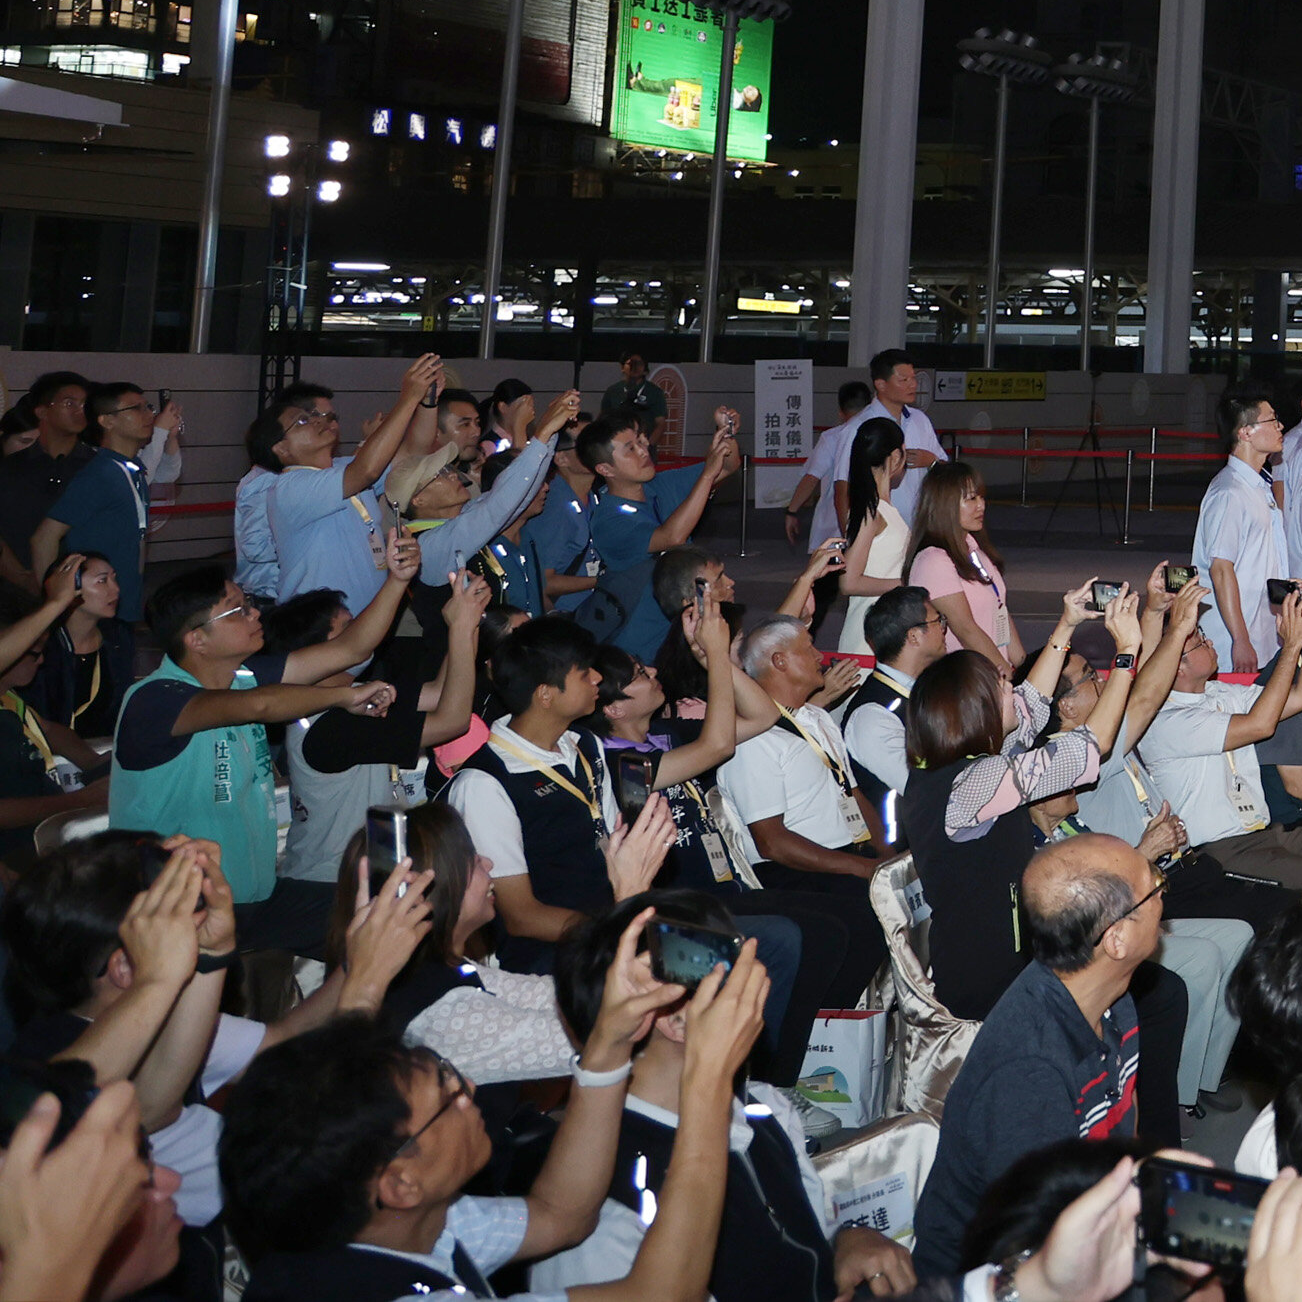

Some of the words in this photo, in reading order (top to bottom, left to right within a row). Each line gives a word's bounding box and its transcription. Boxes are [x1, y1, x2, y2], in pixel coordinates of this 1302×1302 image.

[786, 394, 802, 458] 傳承儀式
[533, 783, 559, 798] KMT
